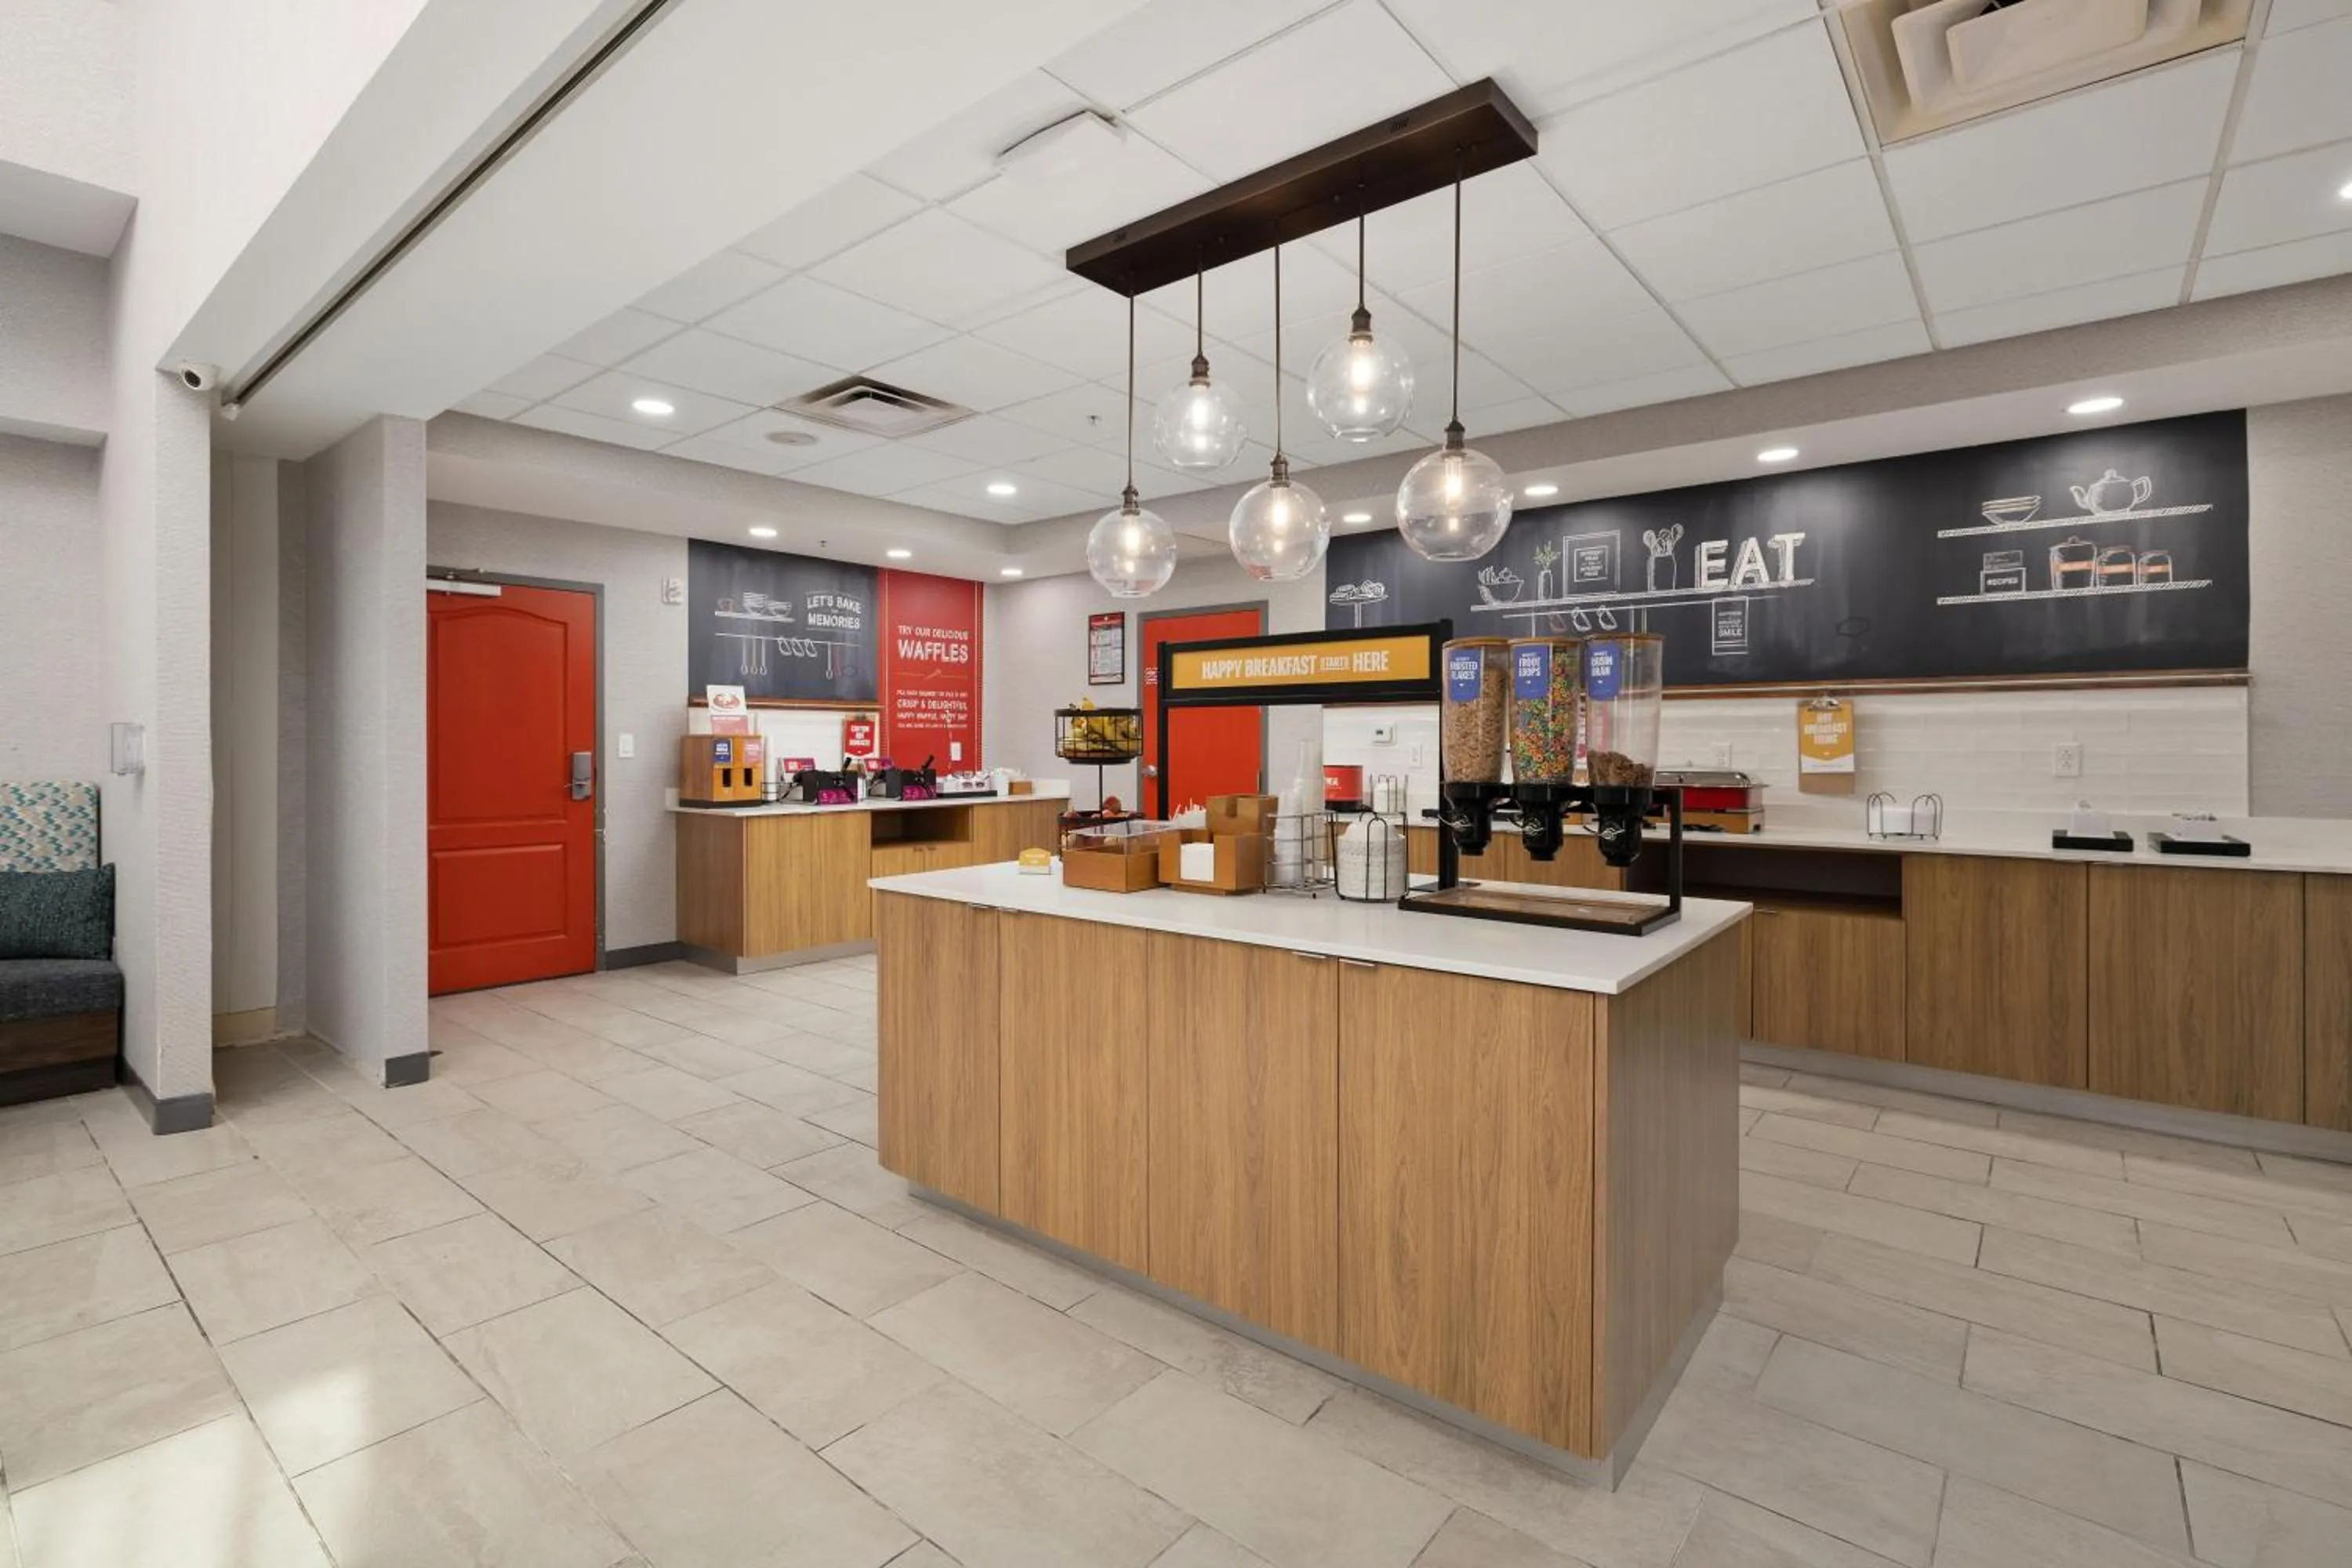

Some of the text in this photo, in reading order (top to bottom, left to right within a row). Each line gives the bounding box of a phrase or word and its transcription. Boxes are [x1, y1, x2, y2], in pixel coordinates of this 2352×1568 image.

[1695, 532, 1806, 588] EAT
[837, 596, 862, 614] BAKE
[808, 612, 860, 630] MEMORIES
[898, 625, 968, 641] TRY OUR DELICIOUS
[897, 639, 968, 664] WAFFLES
[1202, 650, 1390, 680] HAPPY BREAKFAST STARTS HERE
